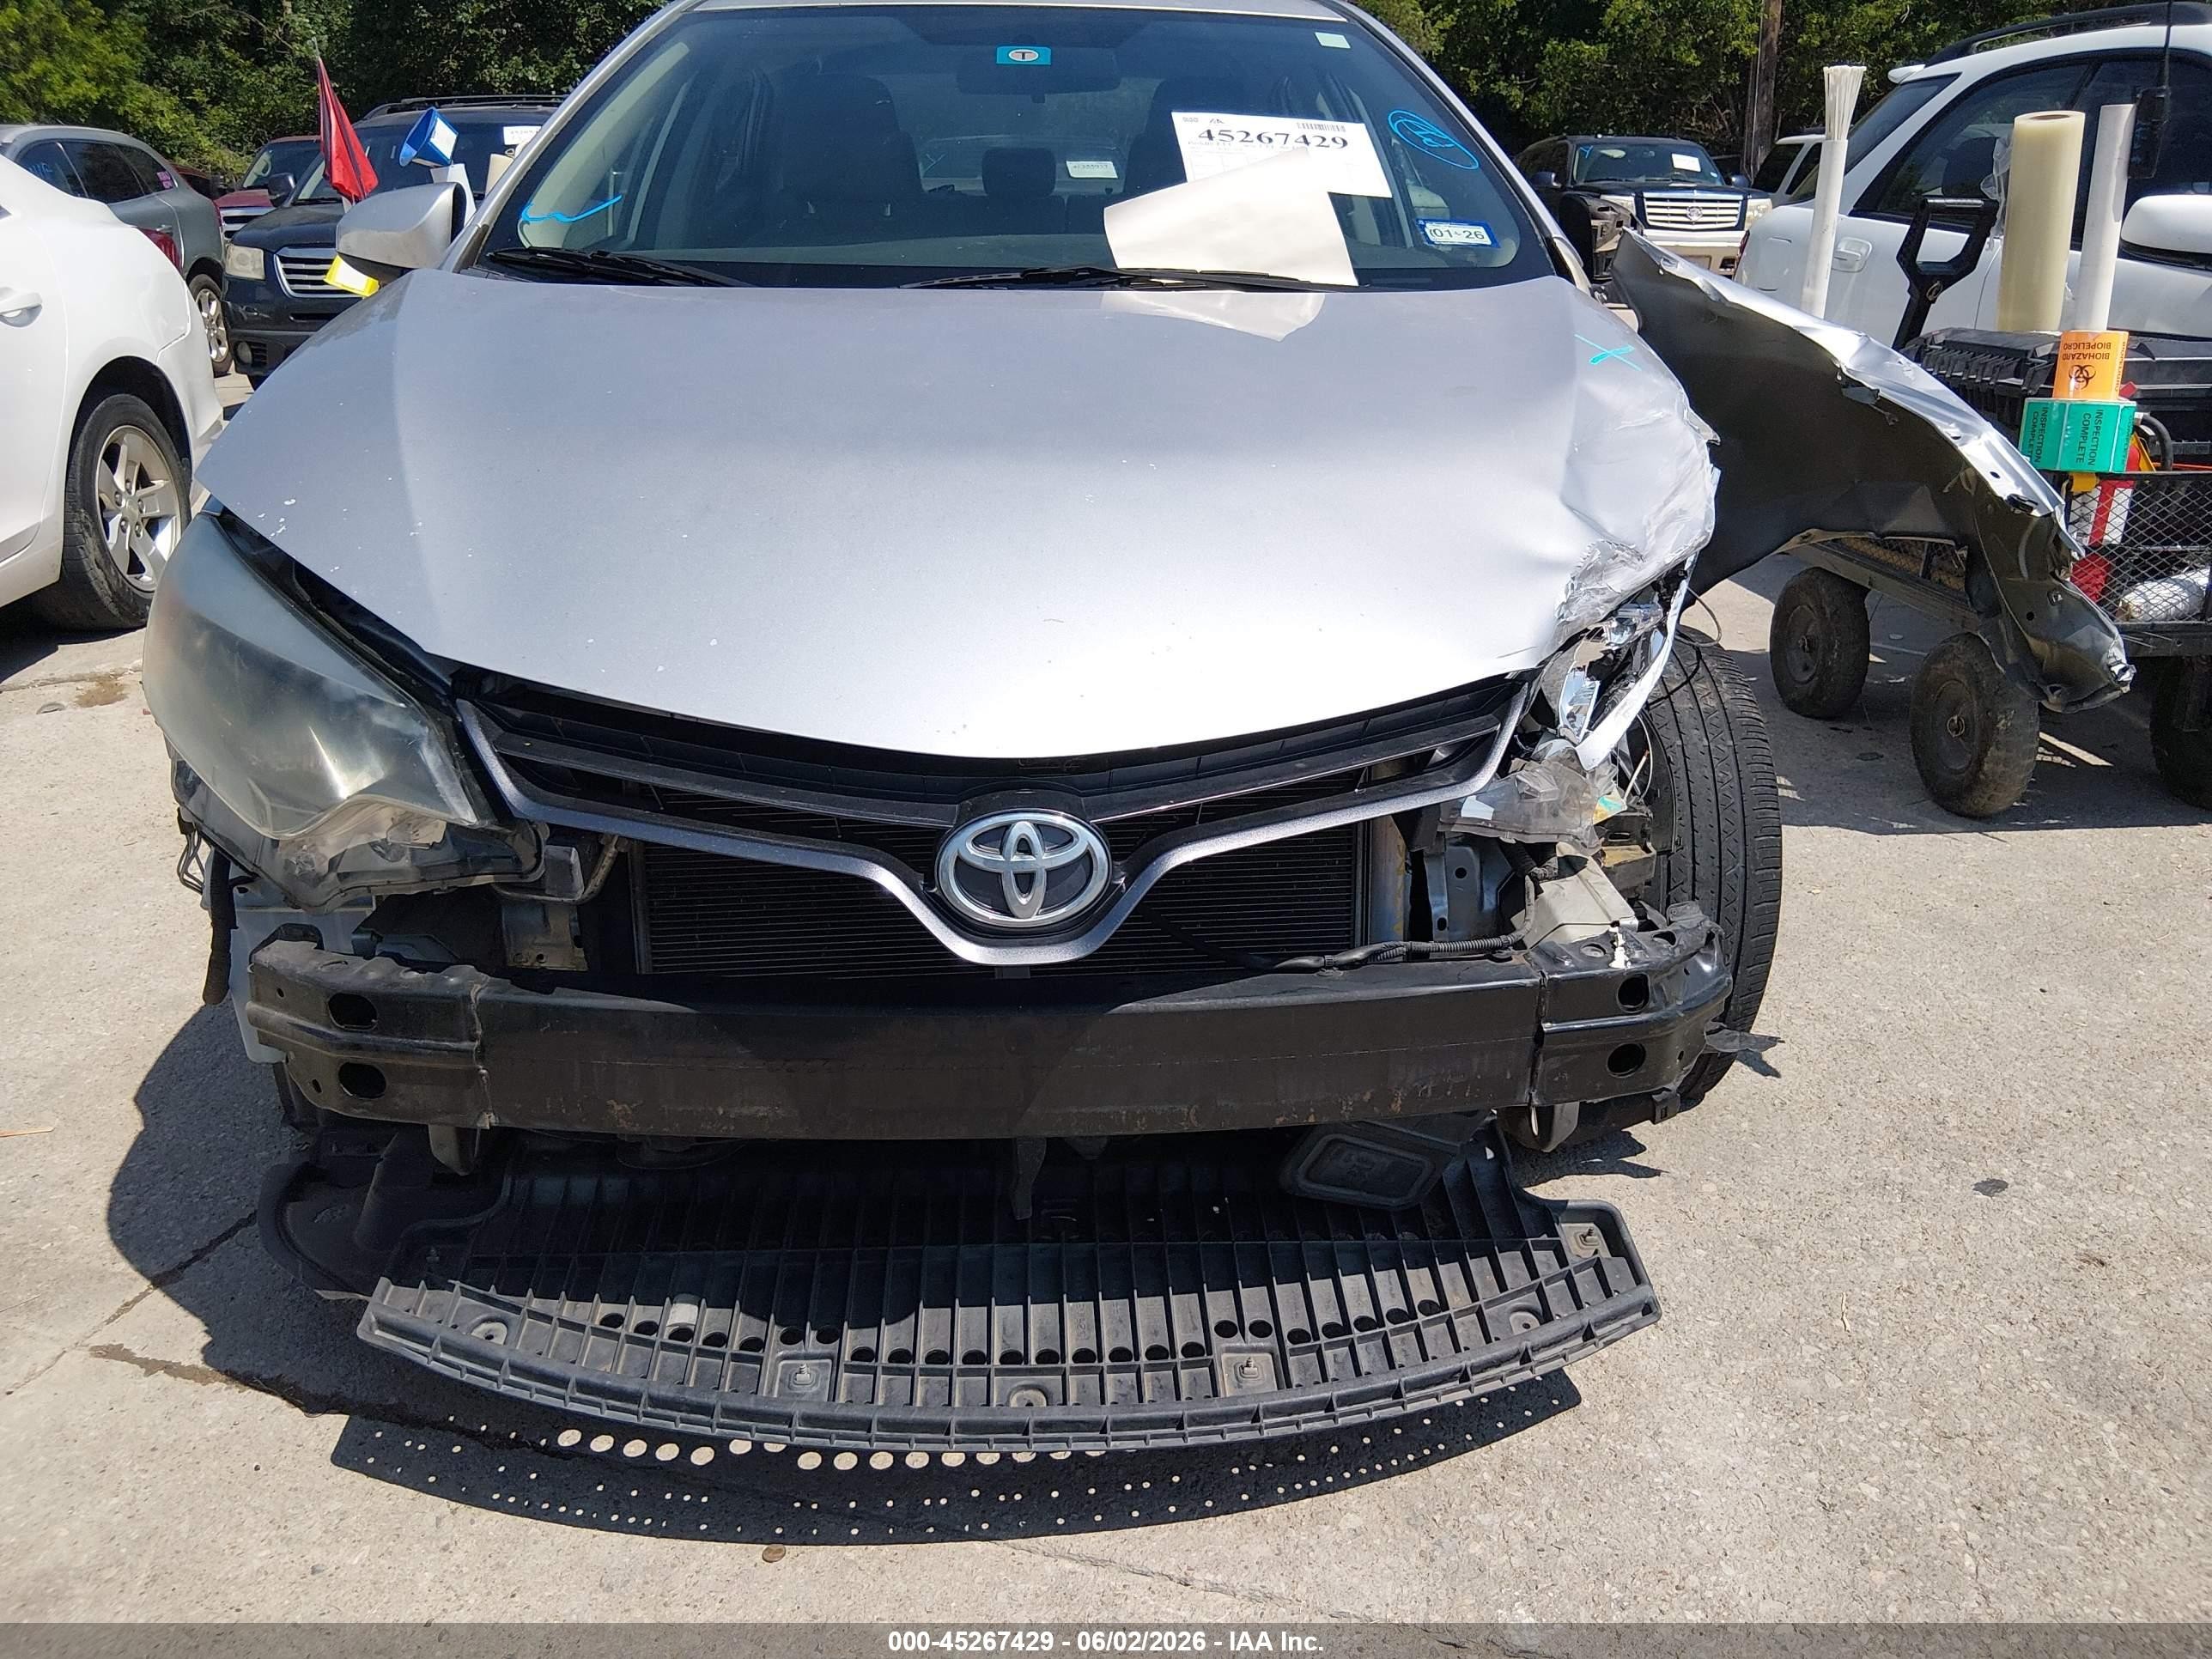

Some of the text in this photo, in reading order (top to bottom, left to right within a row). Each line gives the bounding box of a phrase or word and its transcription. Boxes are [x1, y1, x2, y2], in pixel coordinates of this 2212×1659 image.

[1198, 128, 1348, 149] 45267429
[2062, 352, 2110, 361] BIOHAZARD
[2063, 342, 2112, 350] BIOPELIGRO
[2027, 411, 2039, 457] COMPLET
[2034, 407, 2049, 463] INSPECTION
[2076, 413, 2092, 463] COMPLETE
[2088, 409, 2104, 466] INSPECTION
